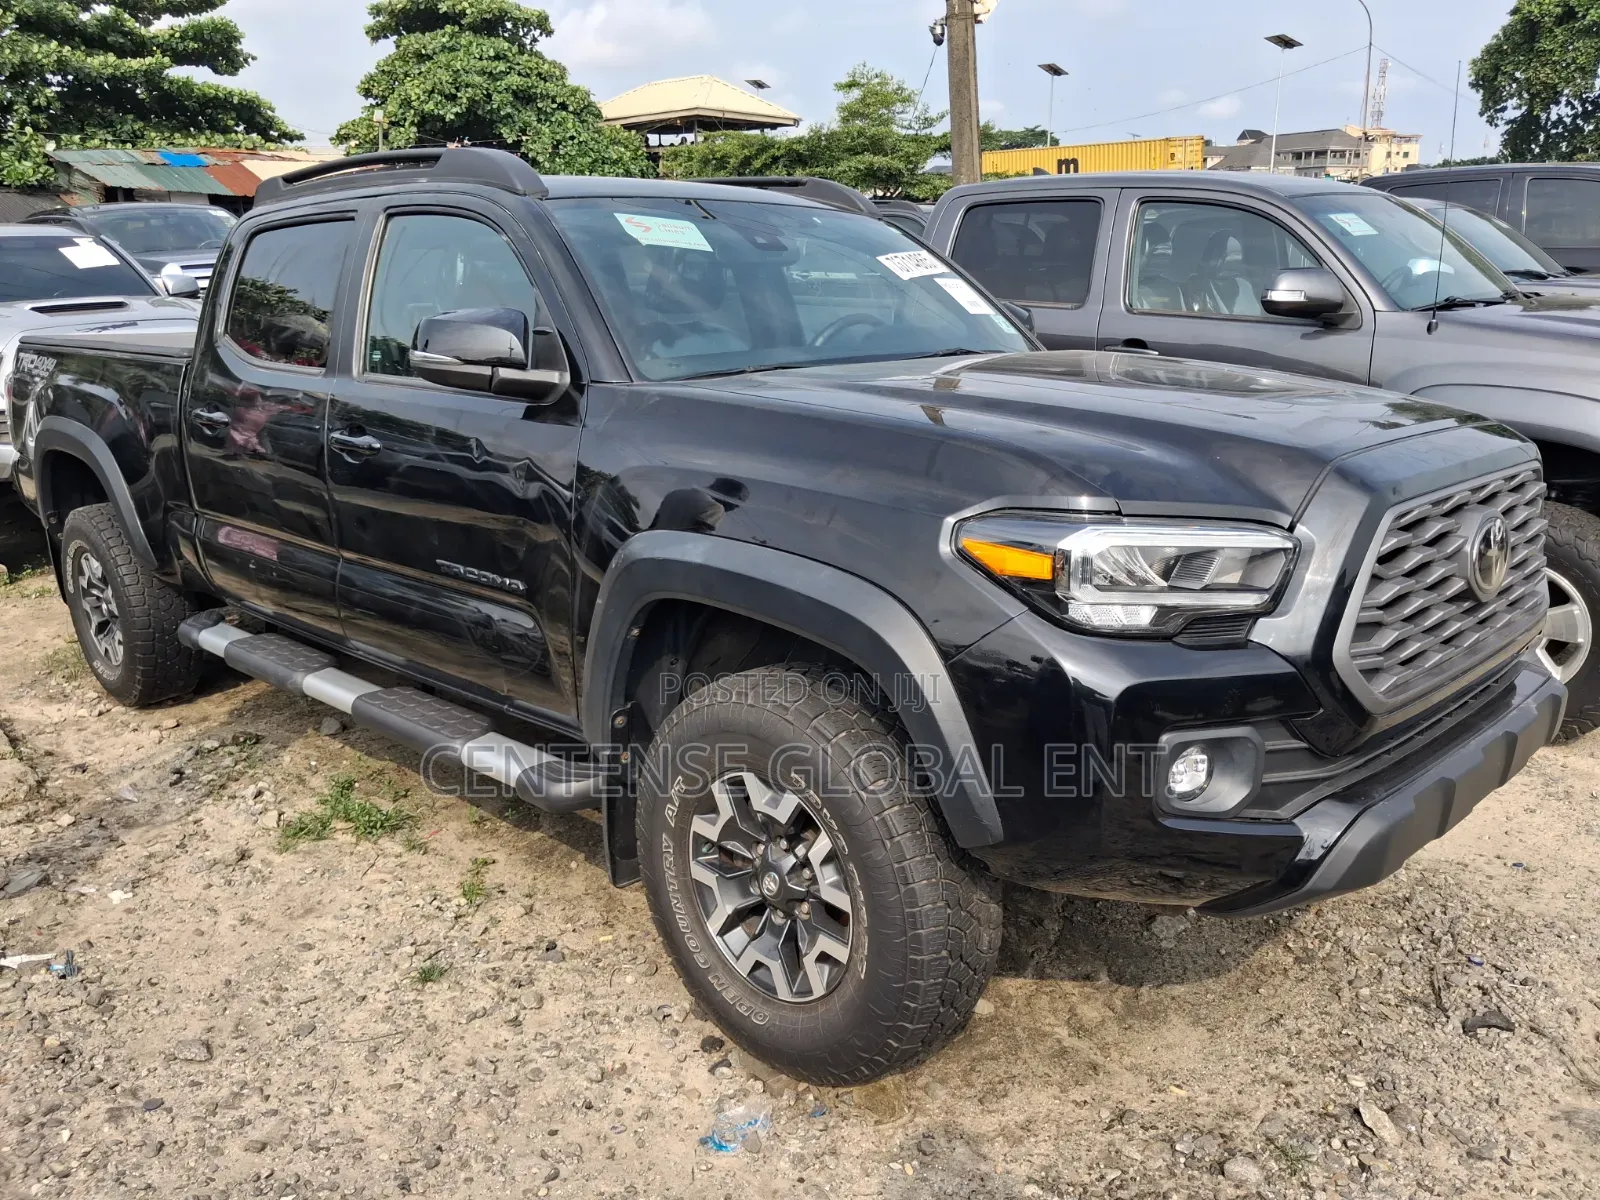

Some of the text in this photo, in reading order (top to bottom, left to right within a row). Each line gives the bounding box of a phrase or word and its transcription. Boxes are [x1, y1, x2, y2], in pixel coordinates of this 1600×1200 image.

[436, 559, 527, 594] TACOMA
[662, 776, 770, 1026] OPEN COUNTRY A/T
